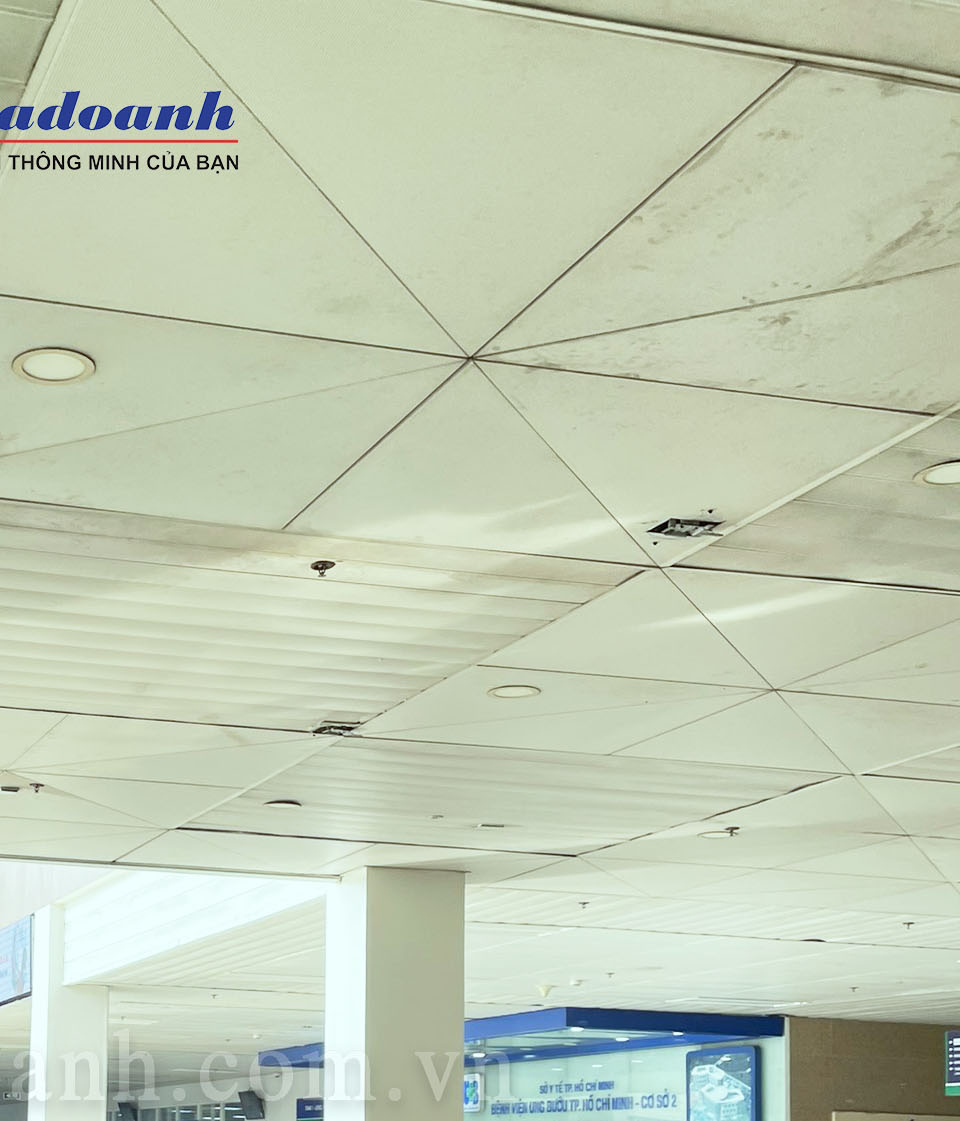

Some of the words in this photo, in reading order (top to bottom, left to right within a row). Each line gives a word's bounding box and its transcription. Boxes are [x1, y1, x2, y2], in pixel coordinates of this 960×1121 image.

[539, 1080, 548, 1095] SỞ
[549, 1083, 554, 1094] Y
[555, 1079, 563, 1093] TẾ
[598, 1080, 615, 1091] MINH
[611, 1097, 634, 1111] MINH
[671, 1094, 678, 1108] 2
